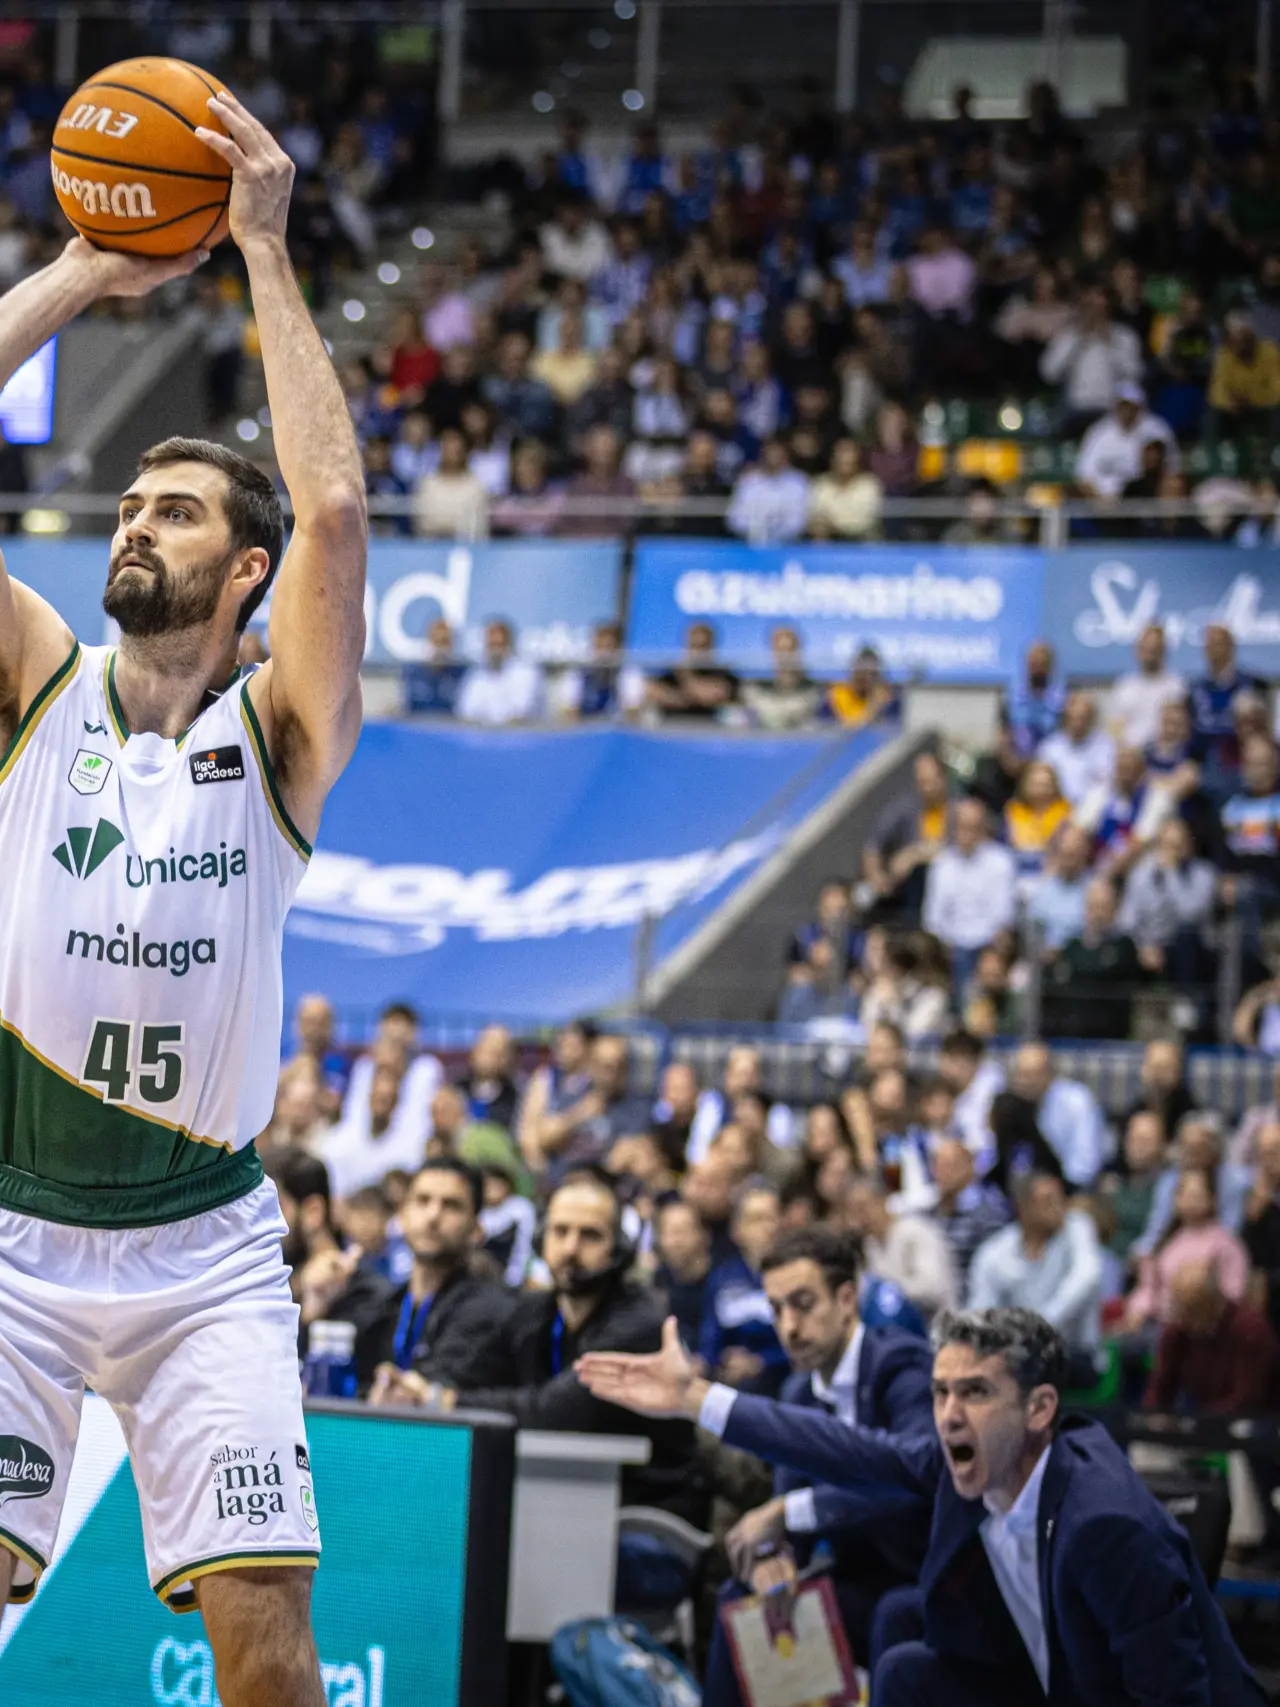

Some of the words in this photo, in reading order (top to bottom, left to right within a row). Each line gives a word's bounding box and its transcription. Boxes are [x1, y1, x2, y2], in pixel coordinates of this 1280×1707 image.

[51, 161, 157, 219] Wilson
[194, 760, 216, 772] liga
[196, 767, 242, 781] endesa
[126, 842, 246, 888] Unicaja
[66, 923, 216, 977] málaga
[80, 1017, 185, 1105] 45
[210, 1445, 258, 1467] sabor
[223, 1451, 285, 1490] má
[216, 1488, 287, 1525] laga
